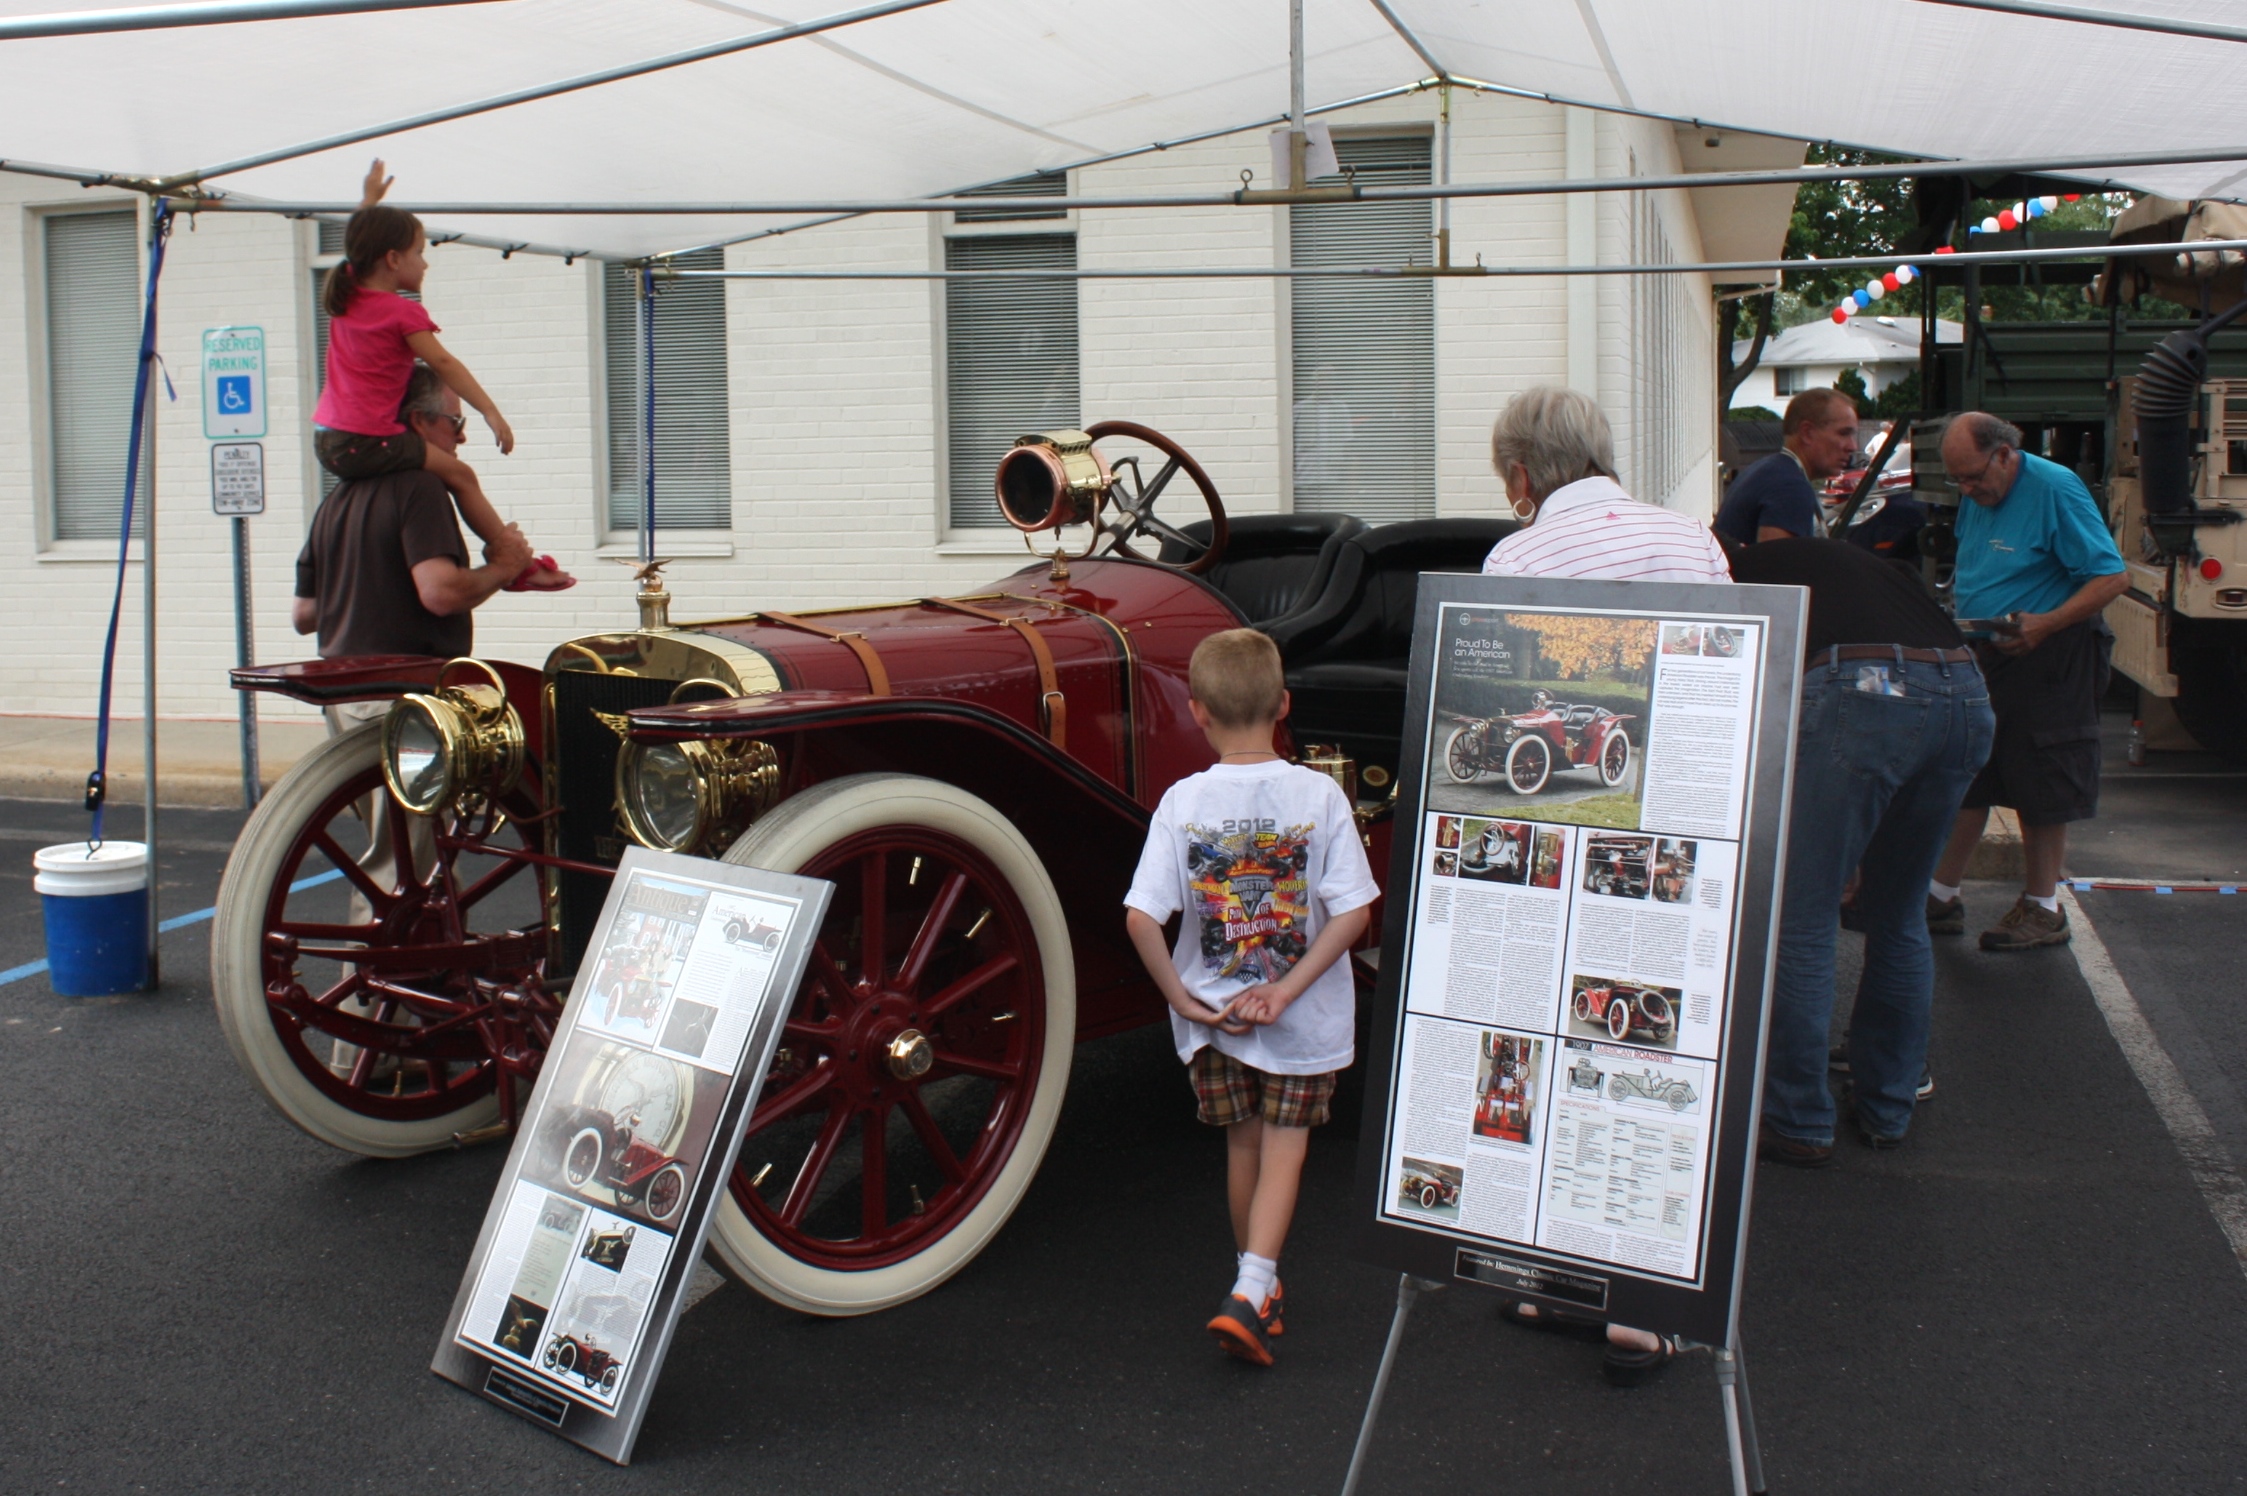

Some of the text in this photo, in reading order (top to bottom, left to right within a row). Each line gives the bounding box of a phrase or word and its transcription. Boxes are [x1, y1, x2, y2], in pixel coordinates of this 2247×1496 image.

[204, 337, 262, 352] RESERVED
[209, 356, 258, 370] PARKING
[1455, 638, 1504, 649] Proud To Be
[1468, 648, 1511, 658] American
[1222, 818, 1276, 833] 2012
[1255, 832, 1278, 841] TEAM
[1230, 879, 1274, 892] MONSTER
[630, 882, 689, 916] Antique
[1260, 903, 1271, 915] OF
[1225, 919, 1278, 941] DESTRUCTION
[1572, 1039, 1590, 1050] 1907
[1593, 1043, 1633, 1058] AMERICAN
[1634, 1050, 1673, 1064] ROADSTER
[1560, 1100, 1600, 1111] SPECIFICATIONS
[1495, 1260, 1530, 1277] Hemmings
[1530, 1269, 1553, 1282] Classic
[1555, 1274, 1568, 1284] Car
[1569, 1277, 1601, 1293] Magazine
[1516, 1278, 1544, 1290] July 2012
